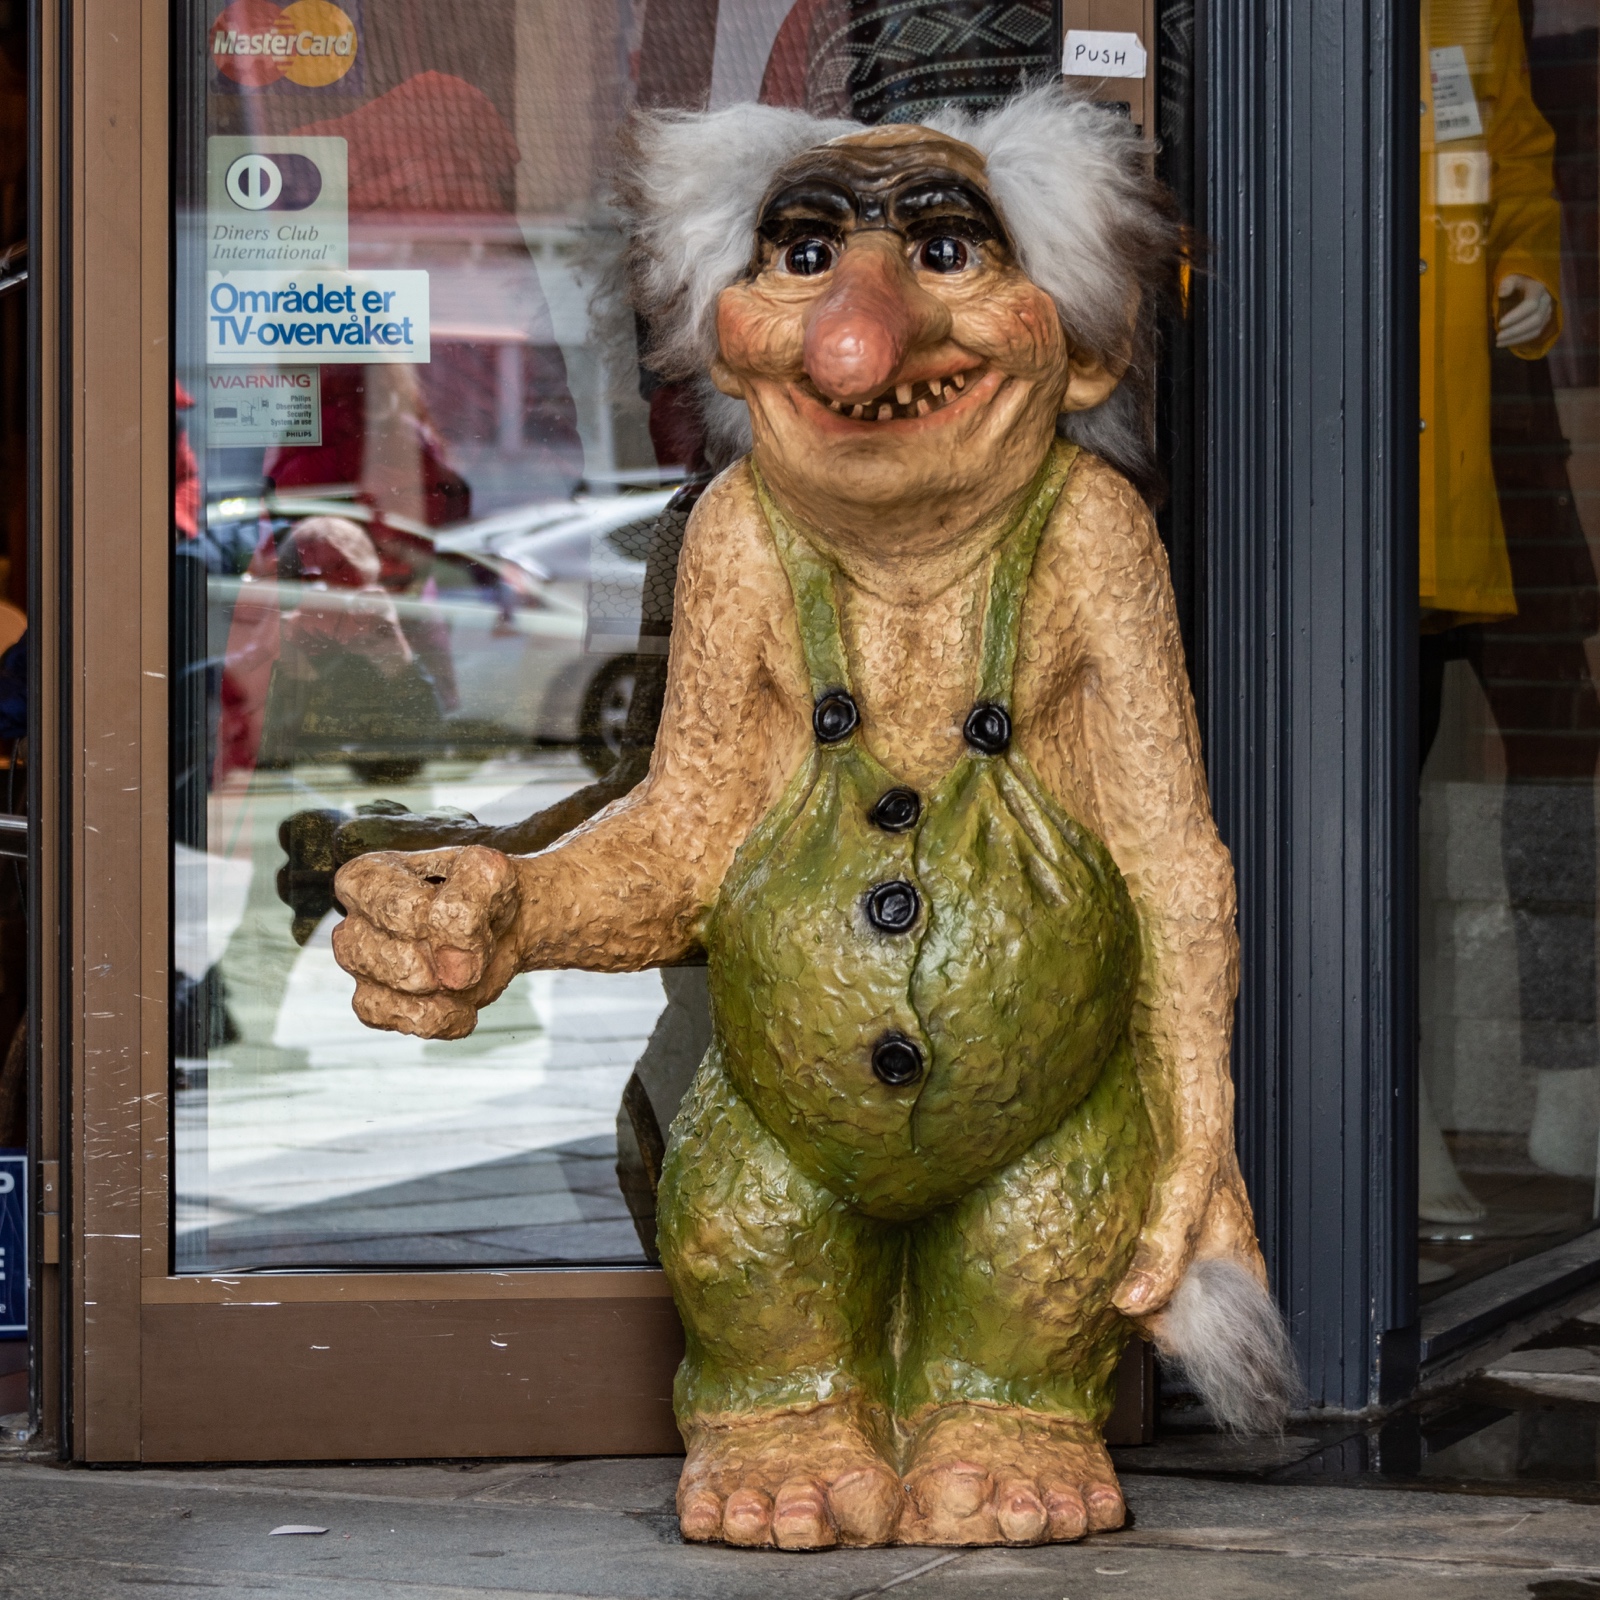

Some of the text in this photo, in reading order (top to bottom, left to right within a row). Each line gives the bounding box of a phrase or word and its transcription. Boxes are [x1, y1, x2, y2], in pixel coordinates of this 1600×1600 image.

[213, 29, 353, 56] MasterCard
[1075, 44, 1126, 65] PUSH
[213, 225, 319, 241] Diners Club
[210, 282, 396, 314] Området er
[210, 314, 414, 346] TV-overvåket
[209, 374, 311, 389] WARNING
[290, 395, 312, 403] Philips
[270, 418, 293, 427] System
